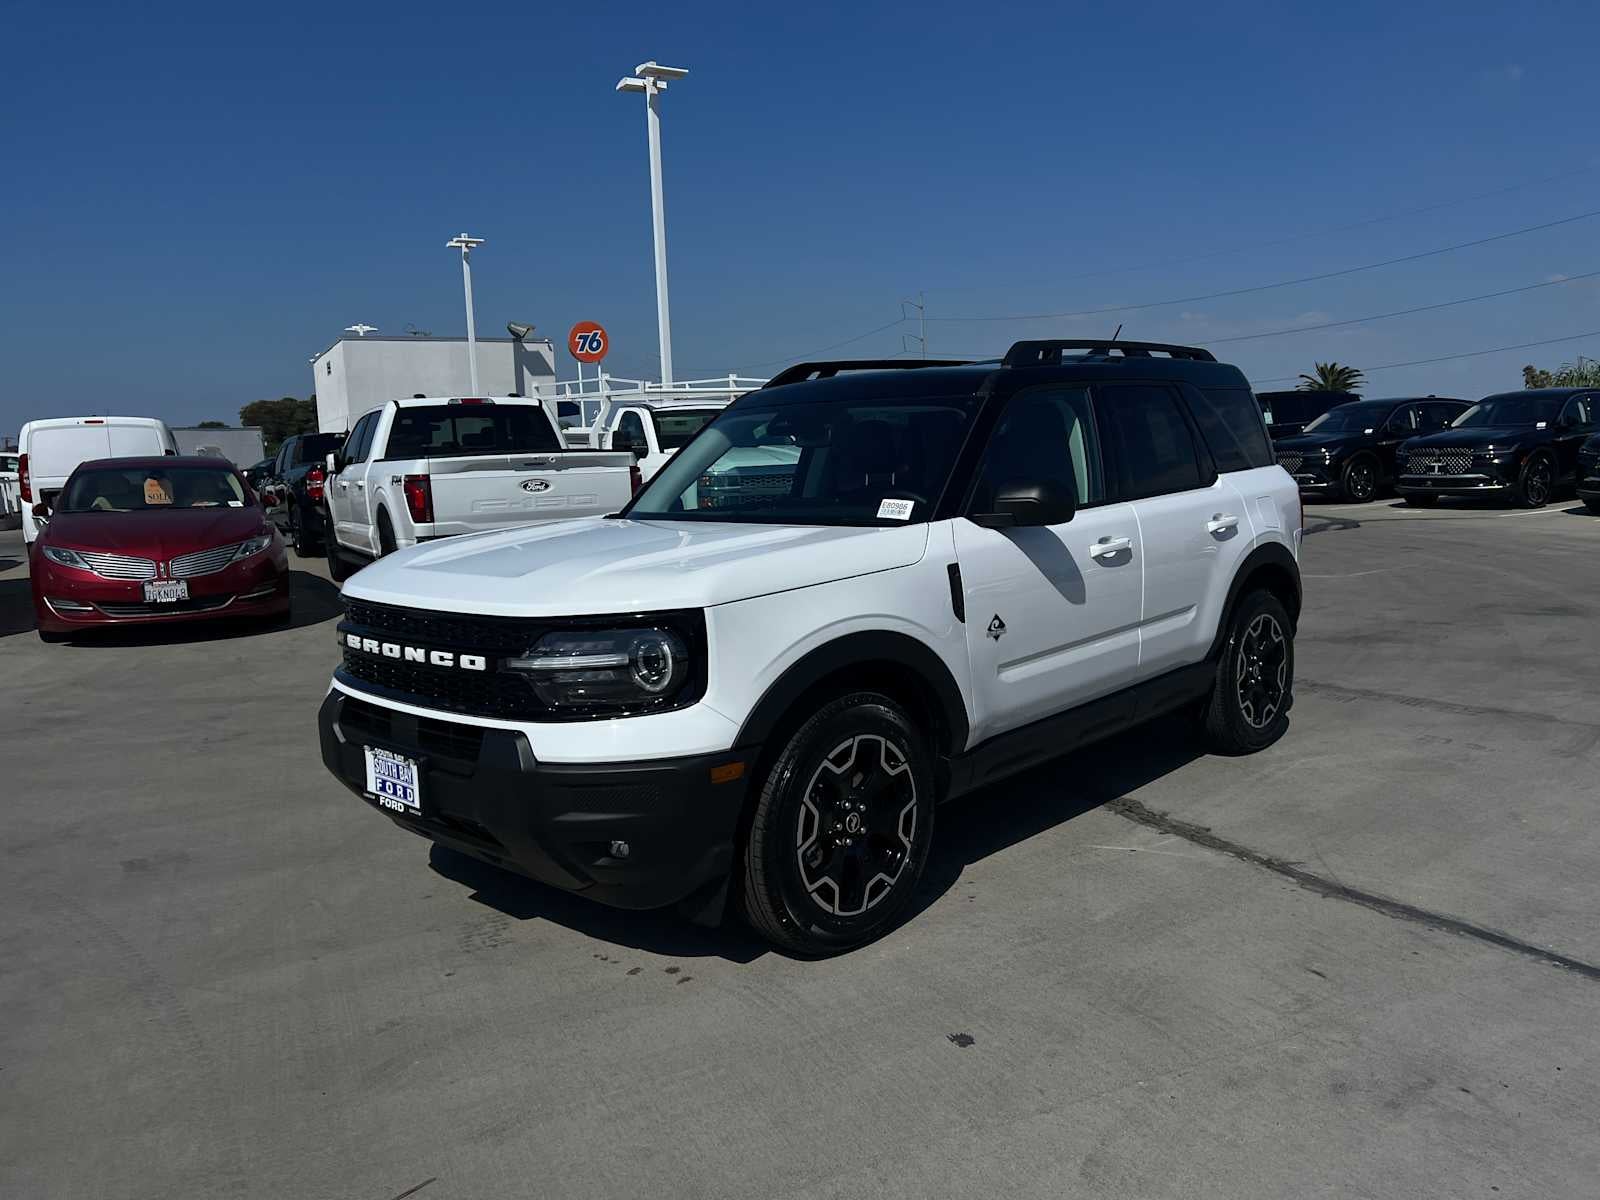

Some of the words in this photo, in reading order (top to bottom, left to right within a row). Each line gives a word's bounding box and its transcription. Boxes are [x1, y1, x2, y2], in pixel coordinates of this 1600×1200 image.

[576, 330, 603, 353] 76
[526, 481, 546, 490] Ford
[346, 634, 486, 671] BRONCO
[375, 759, 398, 778] SOUTH
[398, 766, 413, 784] BAY
[376, 778, 413, 802] FORD
[380, 795, 405, 812] FORD
